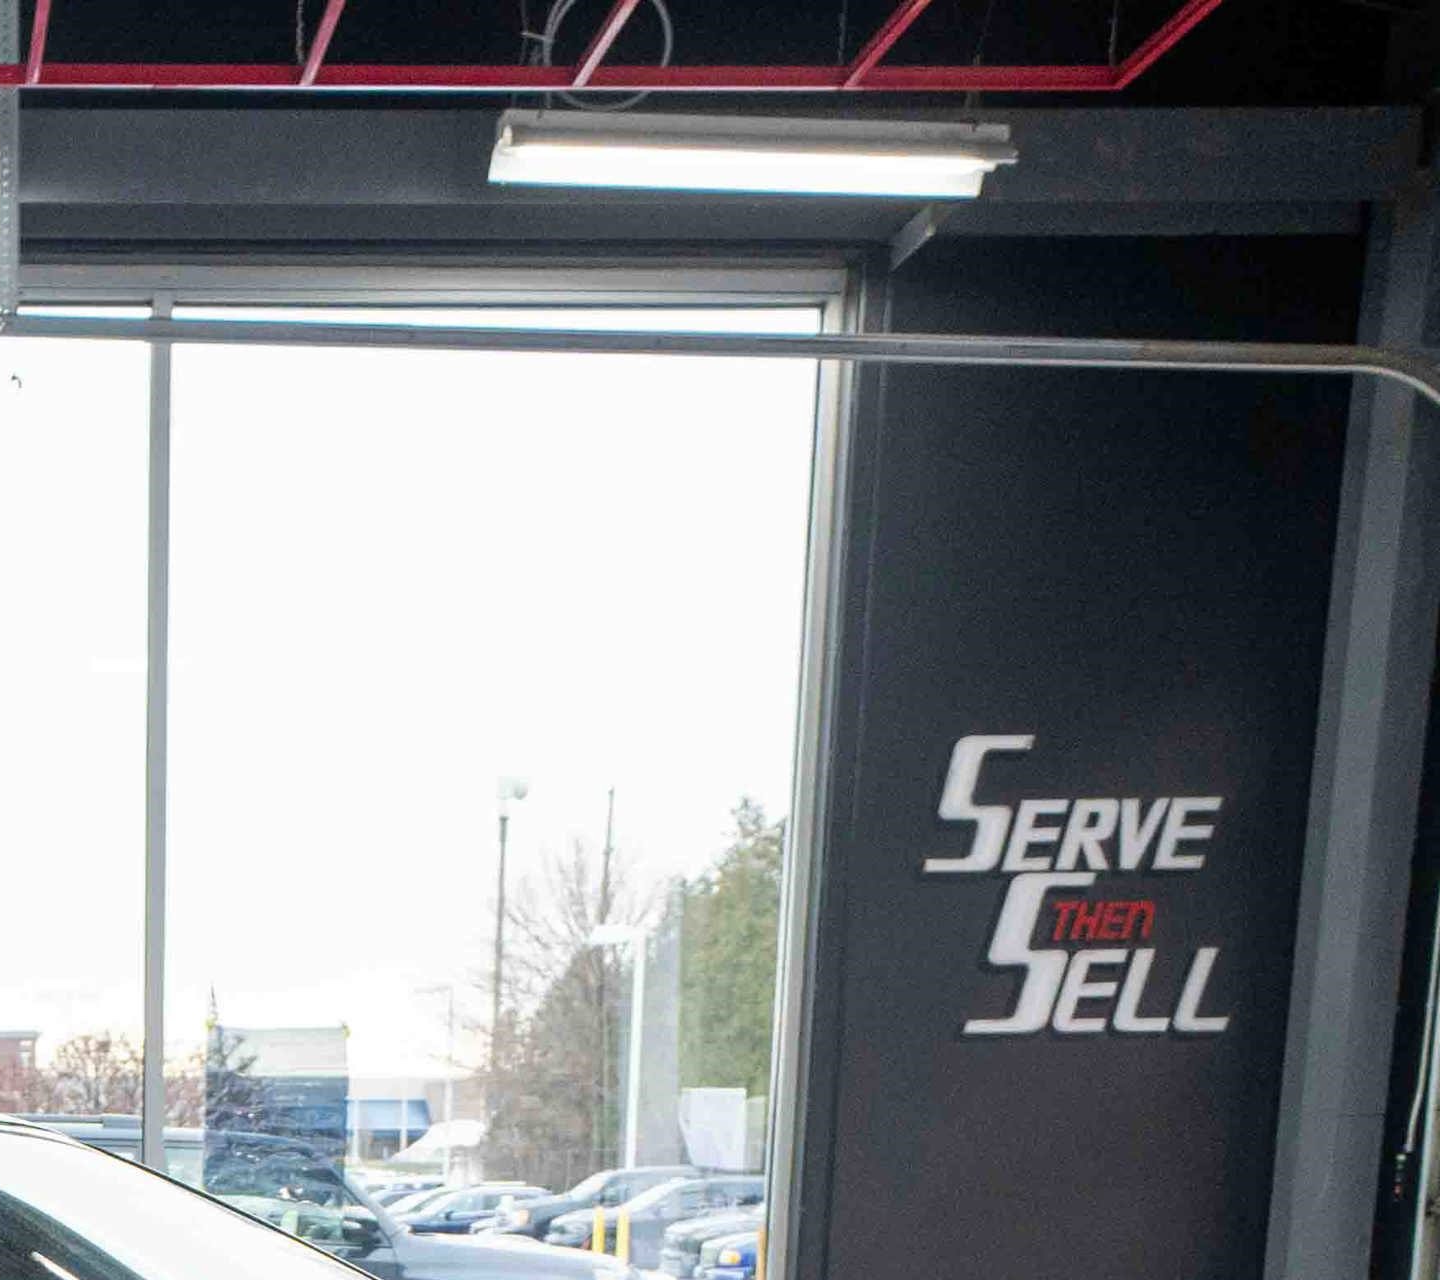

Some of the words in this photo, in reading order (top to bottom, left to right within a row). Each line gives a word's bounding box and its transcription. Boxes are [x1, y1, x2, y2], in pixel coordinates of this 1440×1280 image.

[923, 734, 1223, 873] SERVE
[963, 872, 1230, 1034] SELL
[1050, 899, 1156, 941] THEN
